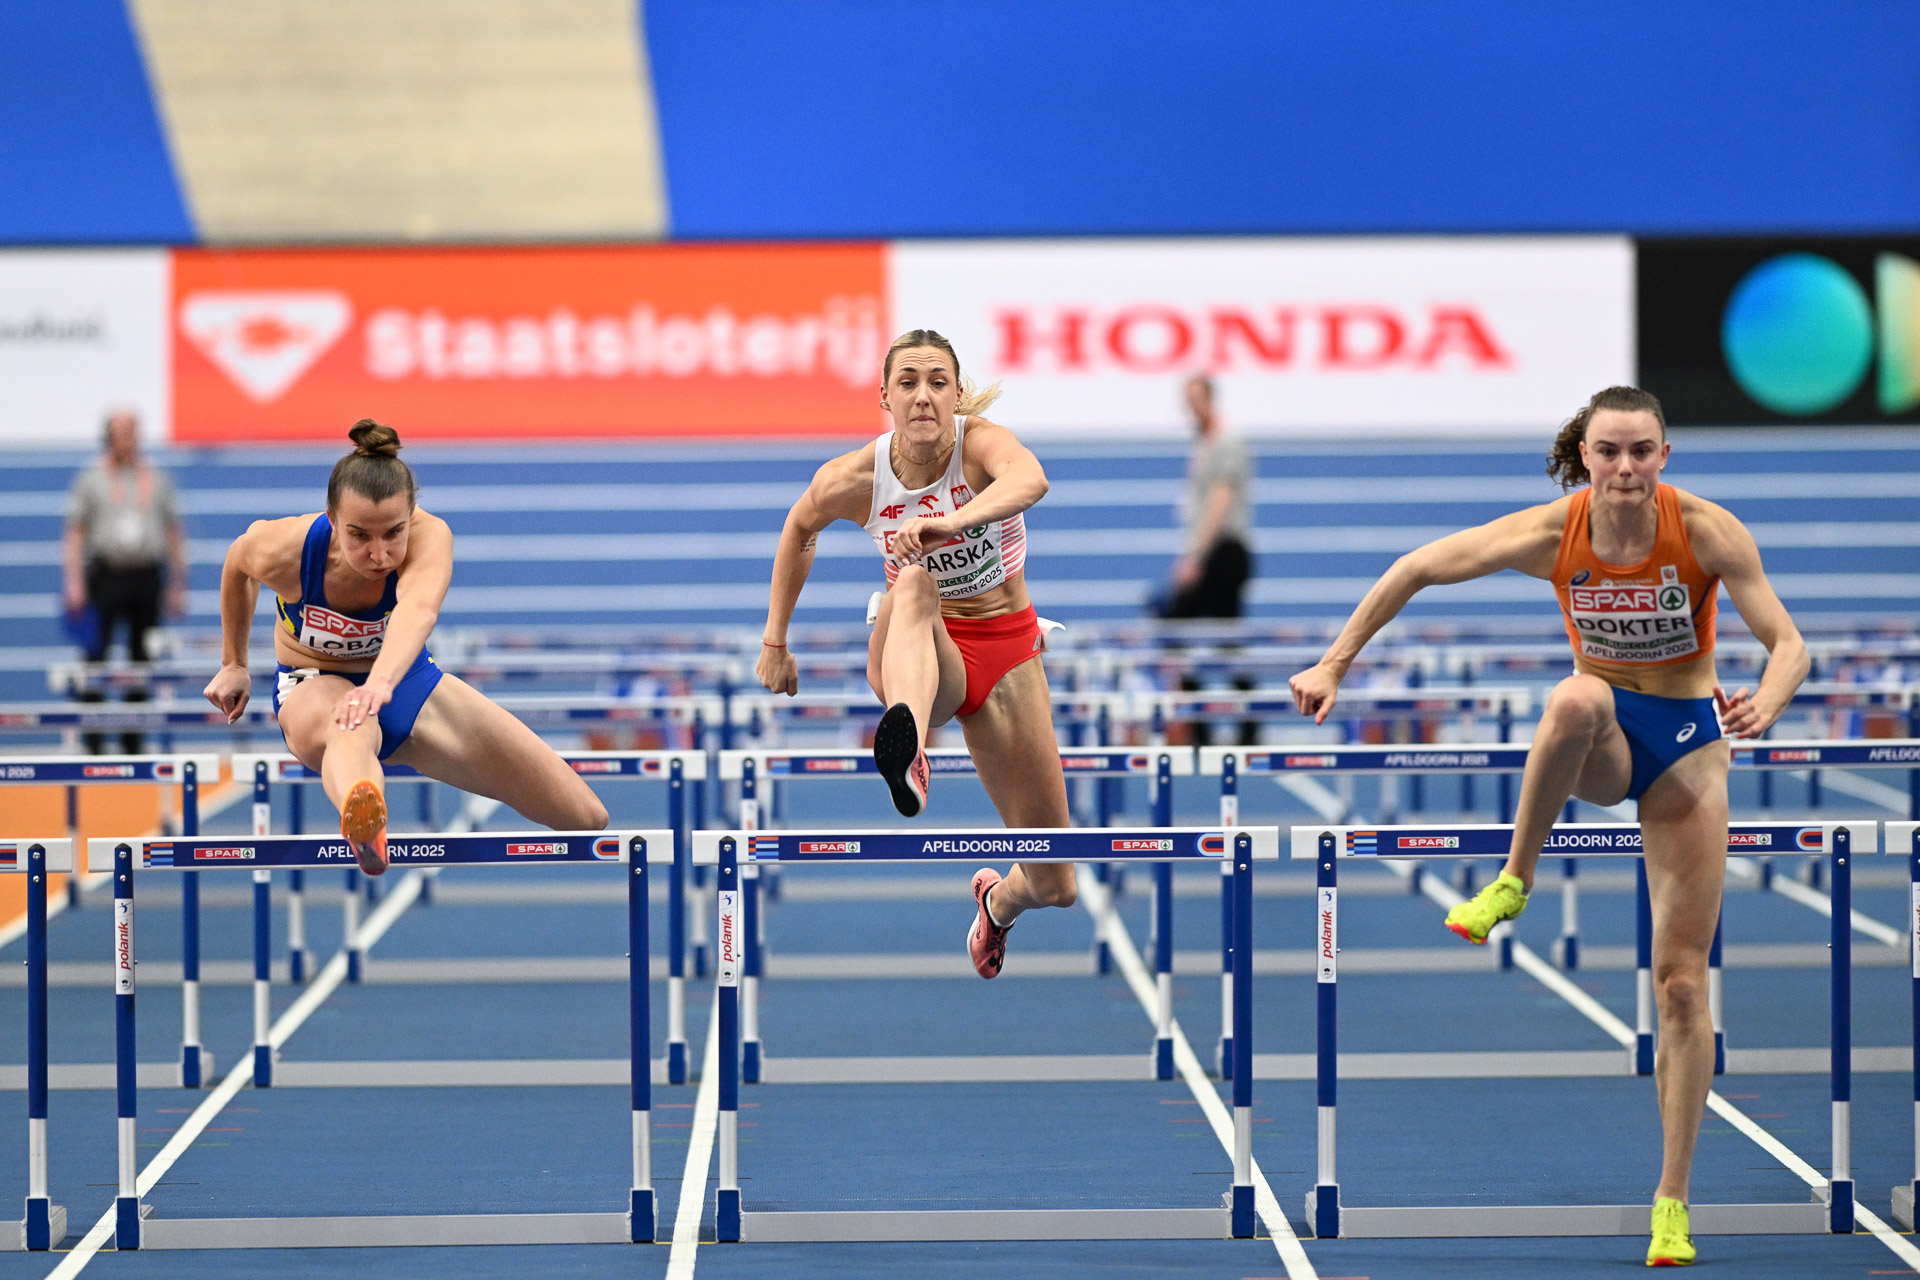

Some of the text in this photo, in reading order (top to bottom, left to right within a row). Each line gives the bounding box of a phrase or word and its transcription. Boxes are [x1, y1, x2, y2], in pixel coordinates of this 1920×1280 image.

[366, 296, 880, 388] Staatsloterij
[995, 302, 1512, 371] HONDA
[879, 504, 906, 519] 4F
[947, 570, 980, 586] CLEAN
[980, 566, 1002, 587] 2025
[1574, 592, 1655, 609] SPAR
[308, 610, 382, 635] SPAR
[1576, 617, 1689, 636] DOKTER
[1586, 641, 1693, 659] APELDOORN 2025
[1384, 754, 1459, 766] APELDOORN
[810, 840, 1158, 853] SPAR APELDOORN 2025 SPAR
[1408, 838, 1444, 847] SPAR
[1615, 835, 1643, 847] 202
[317, 845, 408, 858] APELRN
[411, 845, 445, 857] 2025
[517, 845, 553, 853] SPAR
[721, 913, 734, 962] polanik
[1321, 910, 1334, 959] polanik
[118, 921, 131, 970] polanik
